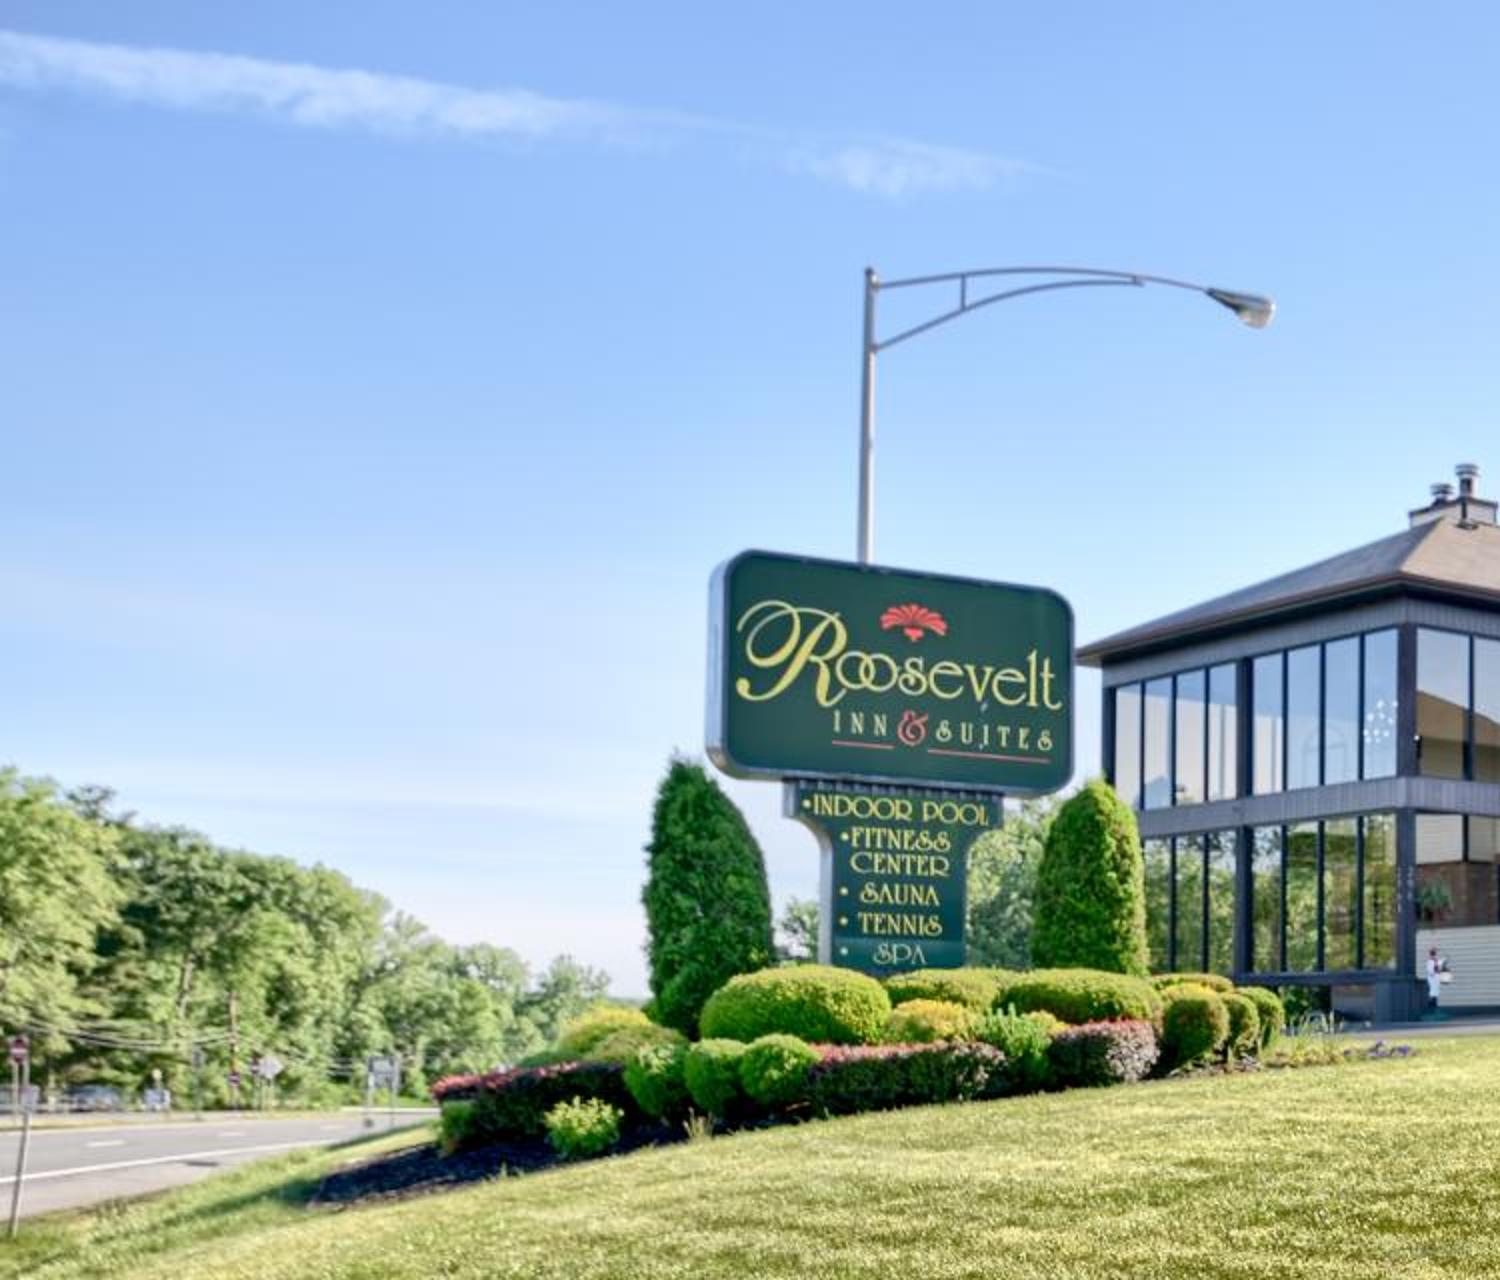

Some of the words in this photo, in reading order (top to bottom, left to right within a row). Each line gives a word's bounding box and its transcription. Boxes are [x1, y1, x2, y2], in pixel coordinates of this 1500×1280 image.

[736, 599, 1063, 710] Roosevelt
[831, 709, 888, 737] INN
[897, 708, 929, 746] &
[935, 719, 1053, 751] SUITES
[813, 793, 913, 822] INDOOR
[922, 801, 989, 826] POOL
[850, 826, 952, 852] FITNESS
[850, 851, 951, 877] CENTER
[860, 881, 941, 907] SAUNA
[857, 911, 943, 937] TENNIS
[872, 942, 928, 966] SPA
